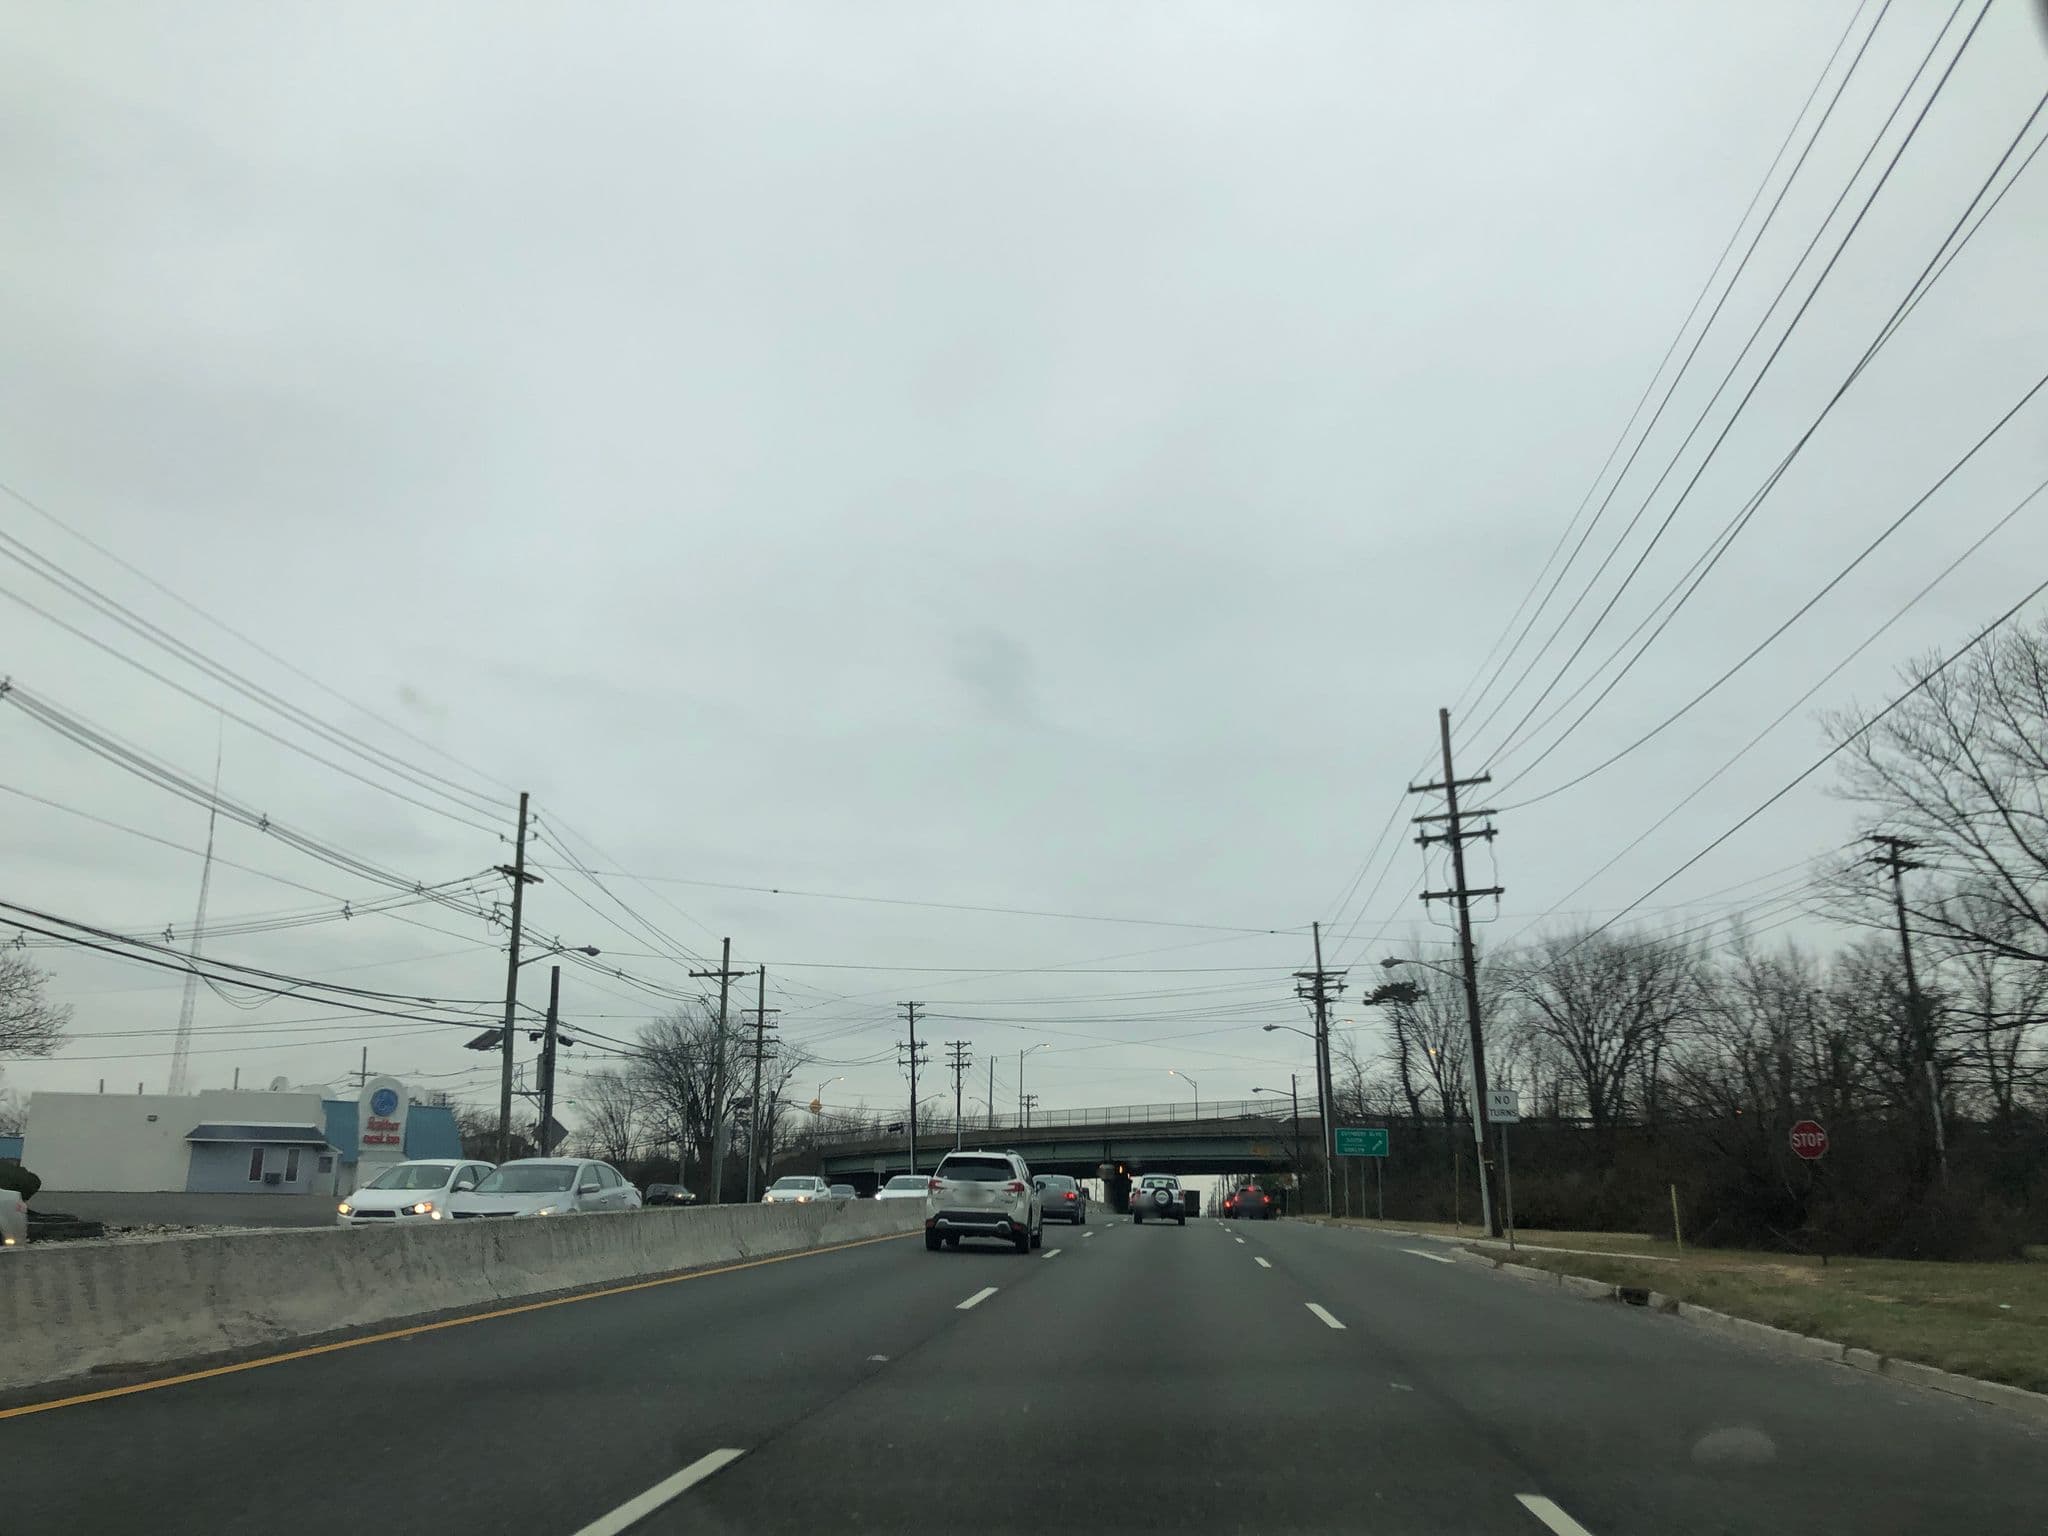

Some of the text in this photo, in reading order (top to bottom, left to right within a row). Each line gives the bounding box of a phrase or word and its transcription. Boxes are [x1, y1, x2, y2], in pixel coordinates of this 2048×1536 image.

[1494, 1095, 1510, 1105] NO
[1490, 1109, 1518, 1117] TURNS
[1792, 1132, 1825, 1147] STOP
